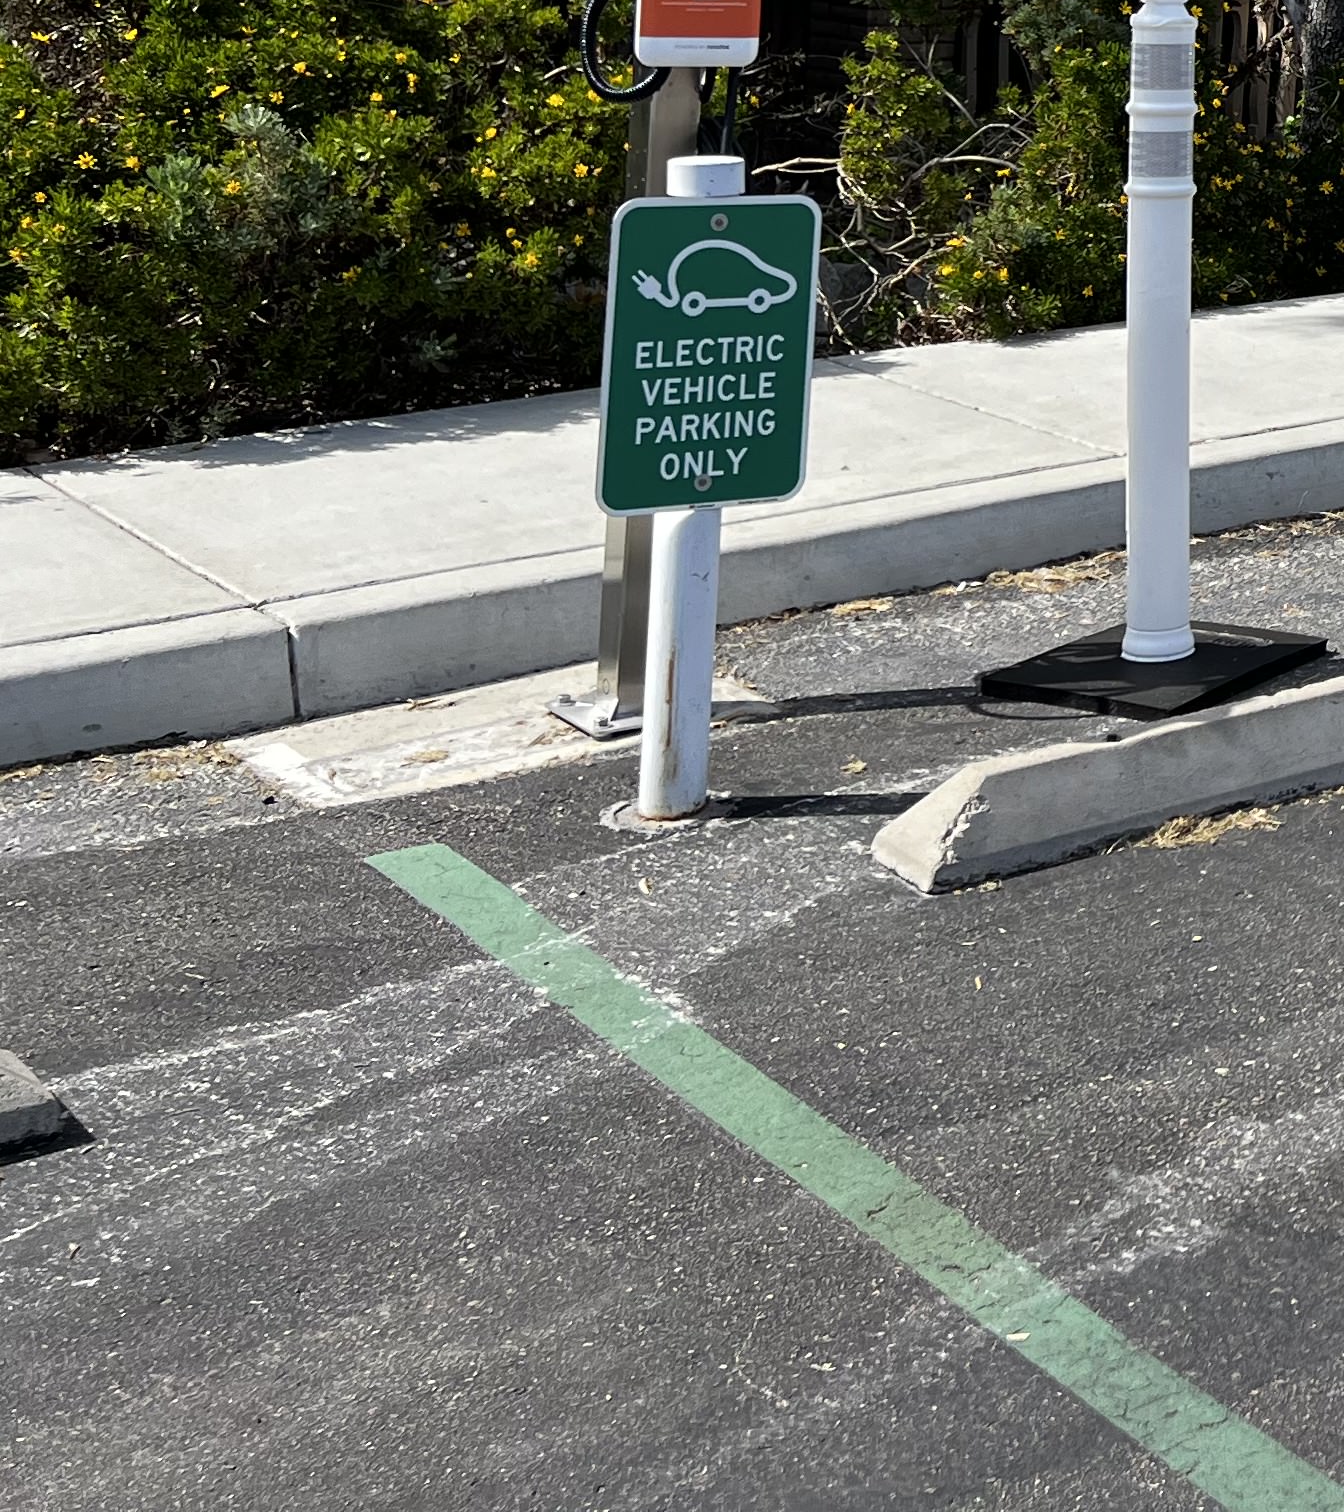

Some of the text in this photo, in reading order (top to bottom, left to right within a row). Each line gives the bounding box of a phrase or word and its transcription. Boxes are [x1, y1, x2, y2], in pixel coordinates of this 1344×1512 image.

[635, 334, 784, 369] ELECTRIC
[642, 372, 776, 406] VEHICLE
[635, 409, 776, 445] PARKING
[660, 447, 748, 480] ONLY
